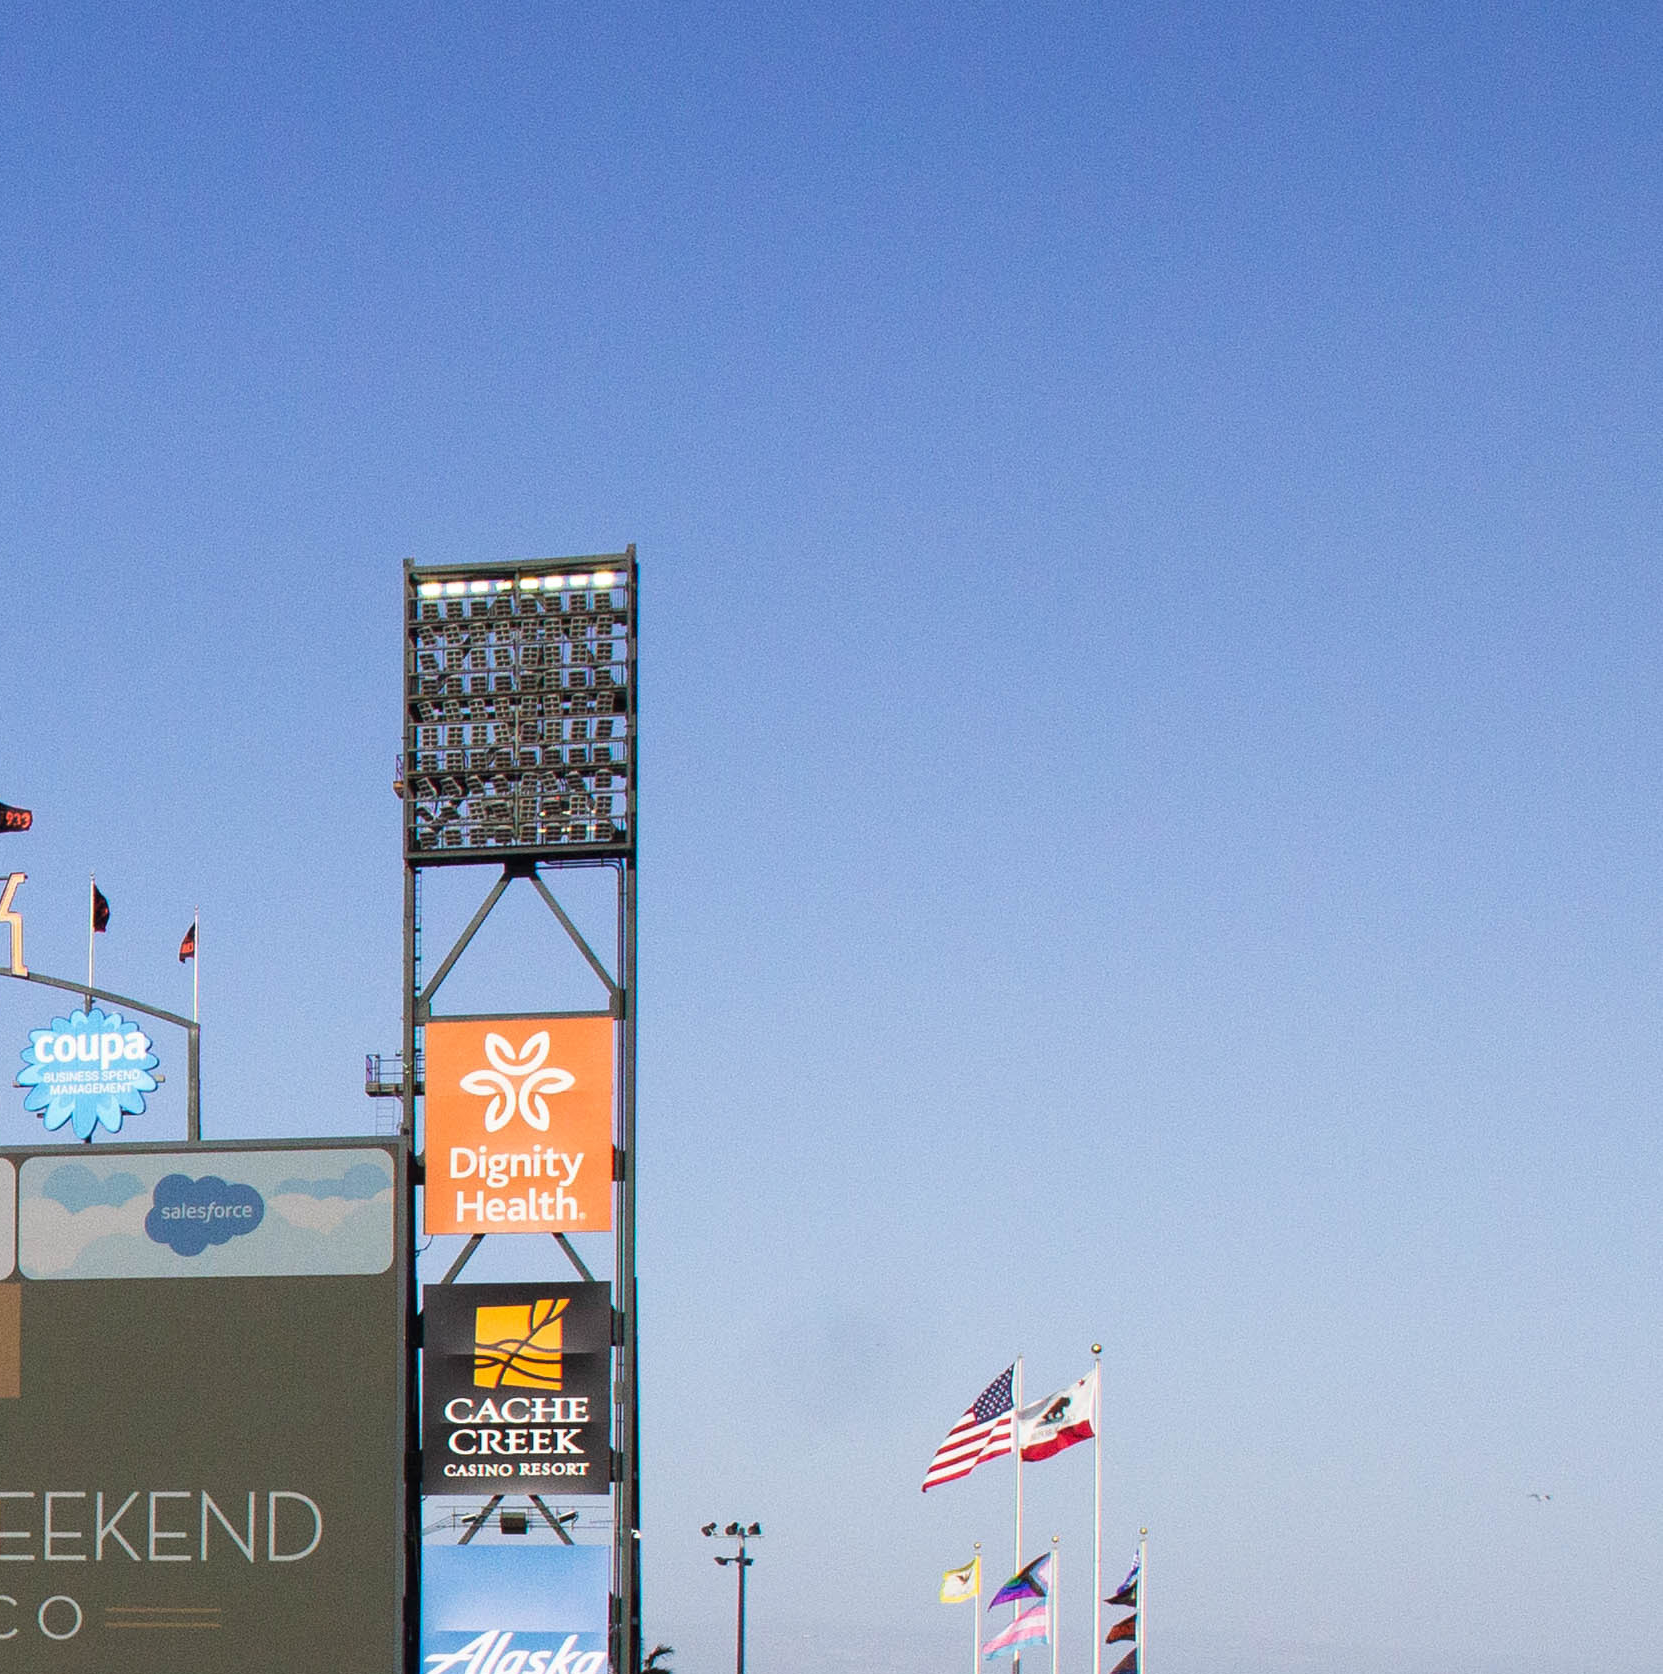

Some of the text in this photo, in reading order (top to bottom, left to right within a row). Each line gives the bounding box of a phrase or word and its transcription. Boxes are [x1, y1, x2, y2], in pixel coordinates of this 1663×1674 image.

[34, 1031, 148, 1069] coupa
[43, 1069, 140, 1083] BUSINESS SPEND
[49, 1083, 132, 1095] MANAGEMENT
[449, 1145, 584, 1188] Dignity
[161, 1202, 253, 1223] salesforce
[456, 1188, 579, 1222] Health
[443, 1397, 589, 1424] CACHE
[448, 1429, 584, 1455] CREEK
[444, 1463, 589, 1477] CASINO RESORT
